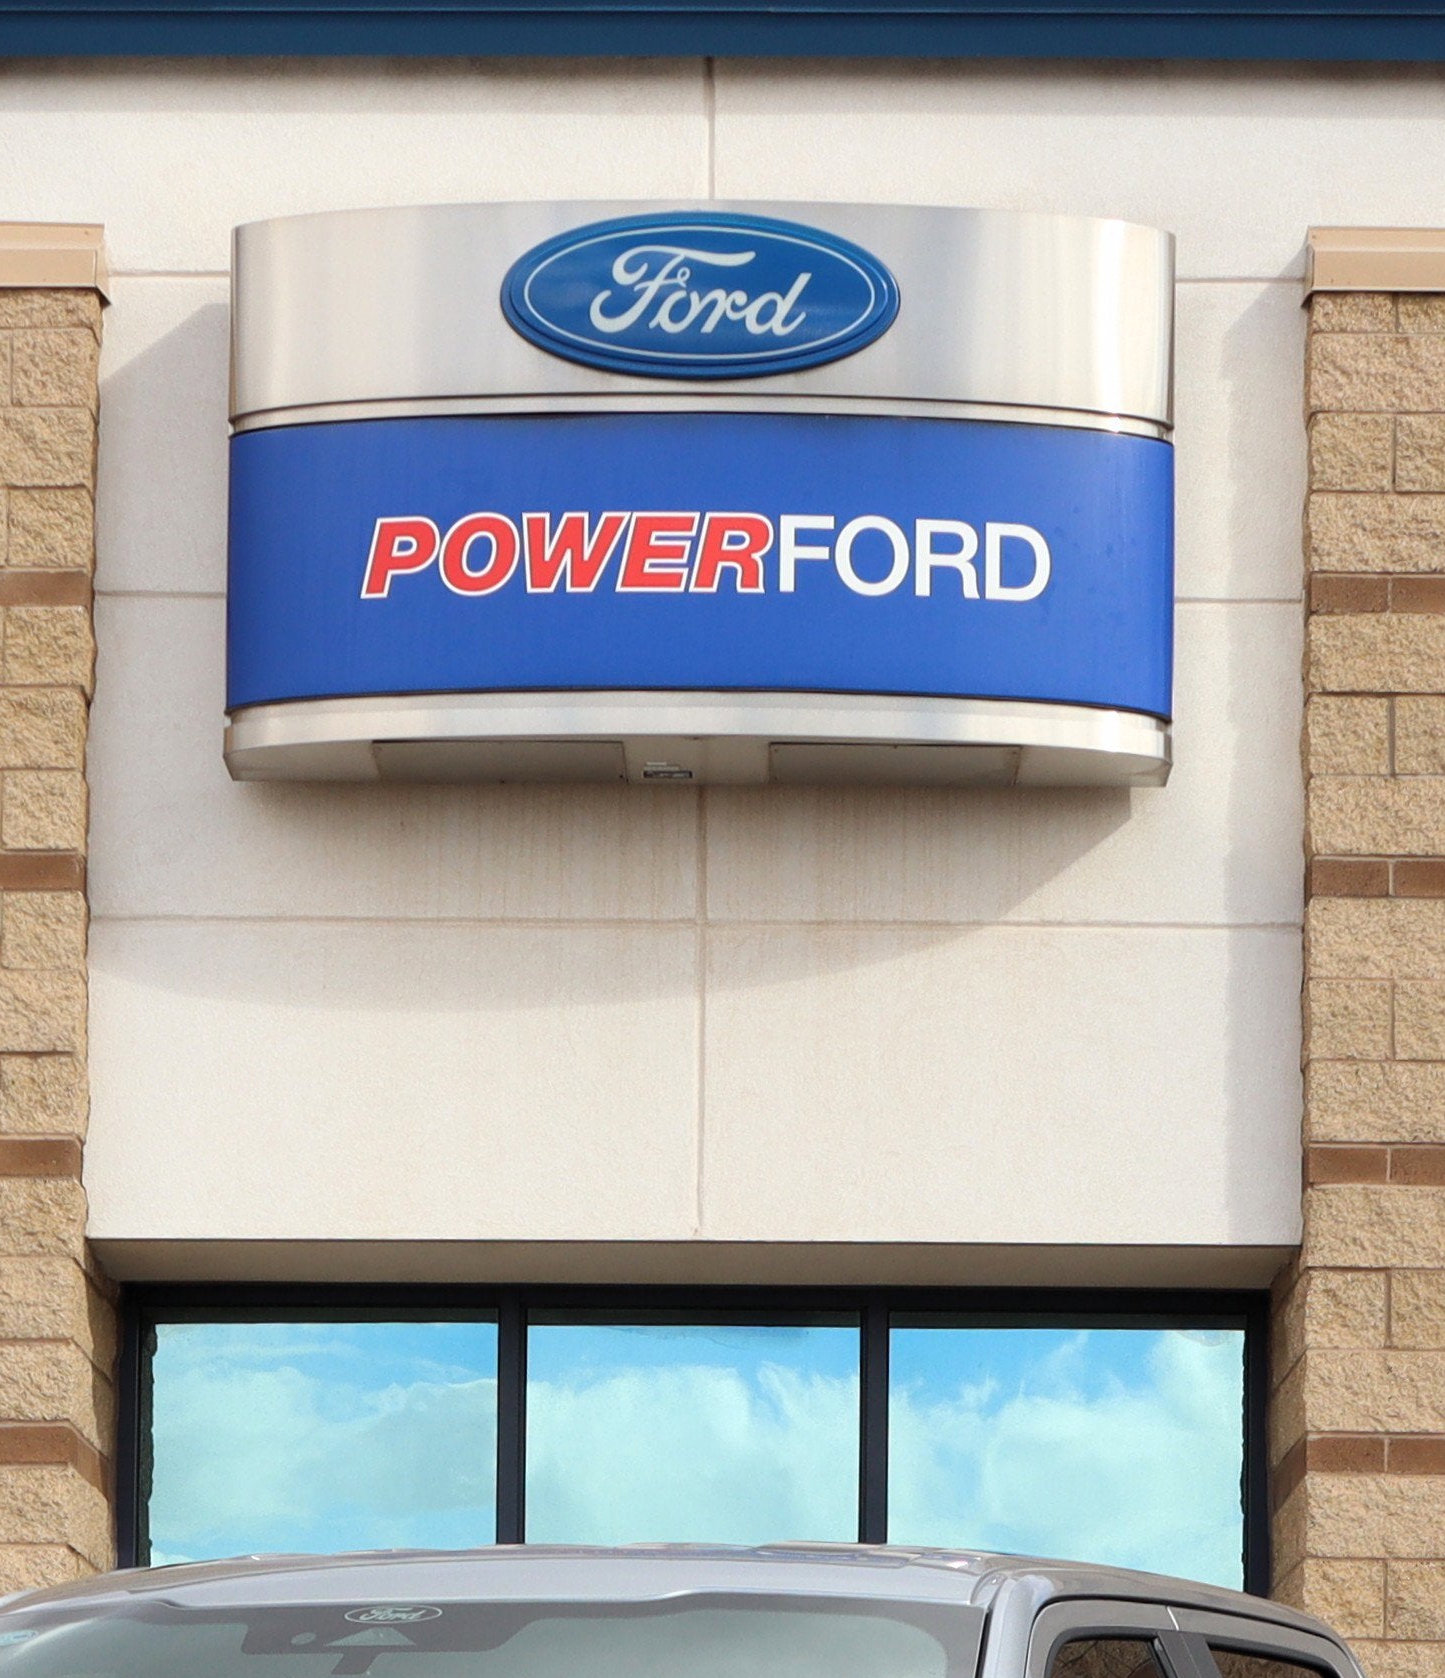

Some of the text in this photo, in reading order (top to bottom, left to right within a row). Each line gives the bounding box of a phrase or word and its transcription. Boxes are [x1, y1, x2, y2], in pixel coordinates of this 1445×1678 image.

[589, 246, 811, 336] Ford
[360, 511, 1051, 602] POWERFORD
[360, 1607, 426, 1621] Ford
